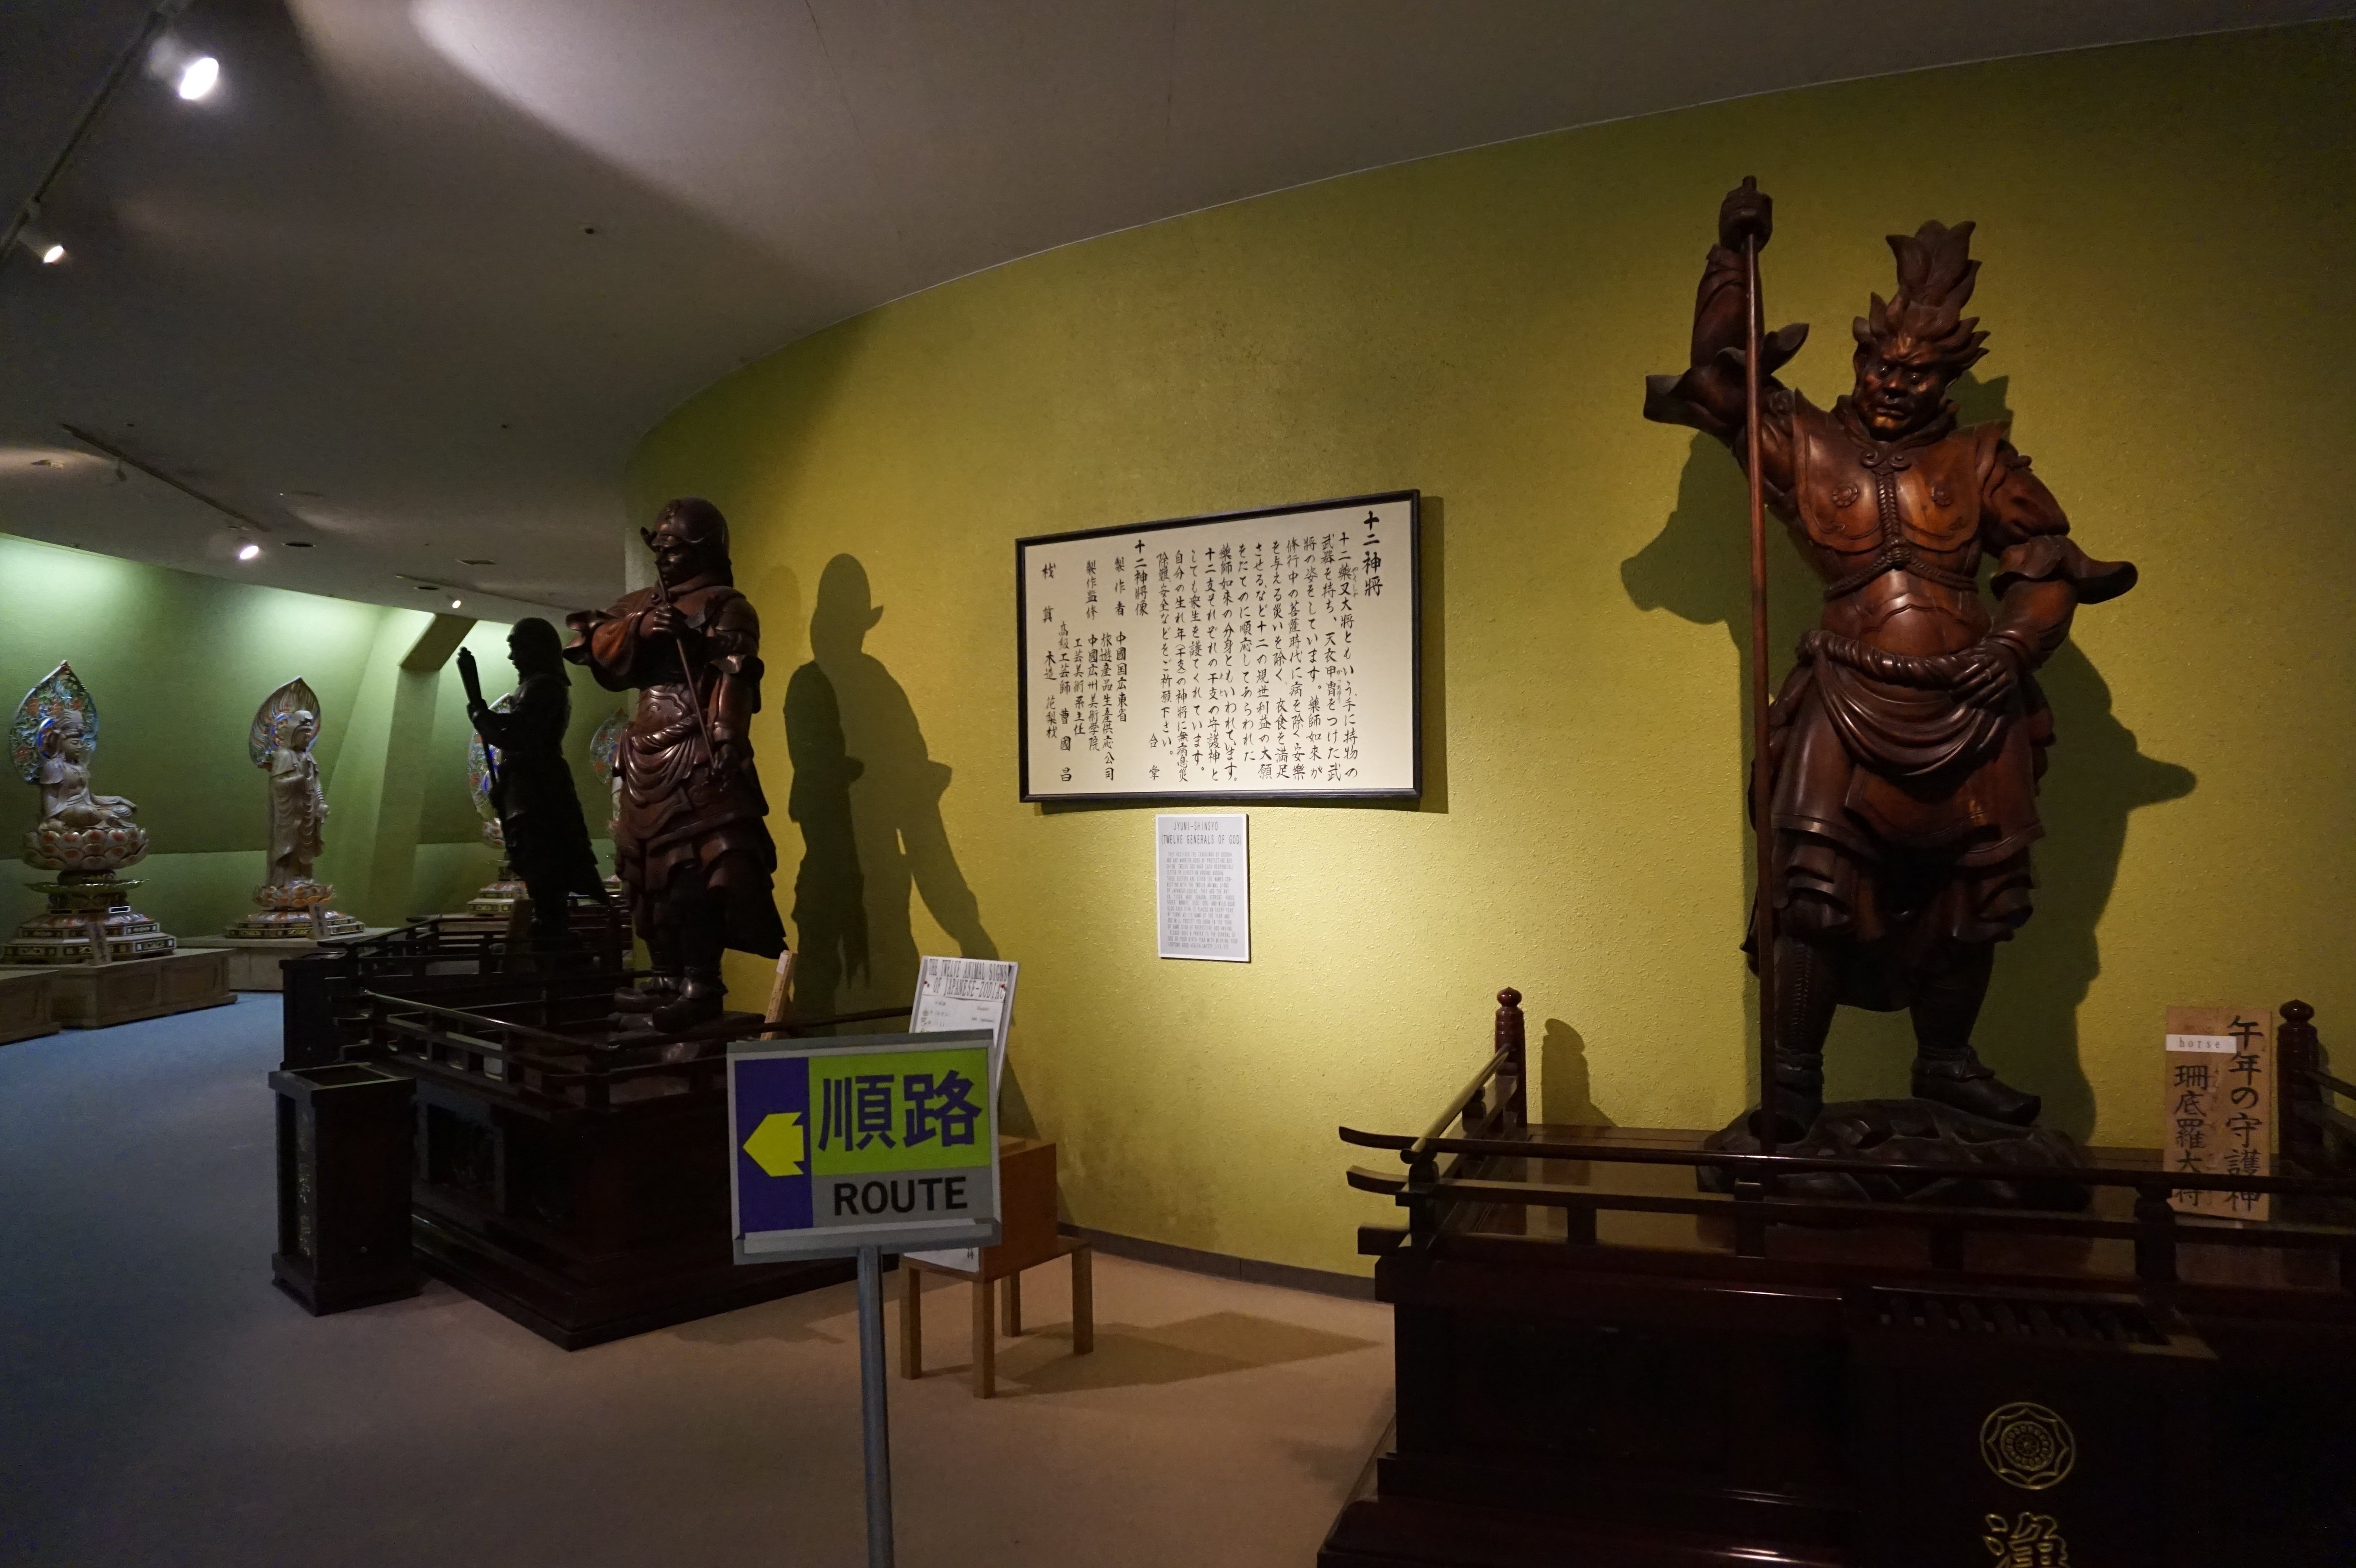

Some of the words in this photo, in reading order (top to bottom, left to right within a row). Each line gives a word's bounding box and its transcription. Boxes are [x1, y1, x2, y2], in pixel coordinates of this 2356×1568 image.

[1187, 835, 1214, 844] GENERALS
[1218, 835, 1225, 844] OF
[963, 961, 985, 980] ANIMAL
[989, 964, 1008, 982] SIGNS
[933, 977, 942, 993] OF
[2179, 1037, 2221, 1049] horse
[818, 1070, 982, 1152] 順路
[833, 1176, 968, 1217] ROUTE
